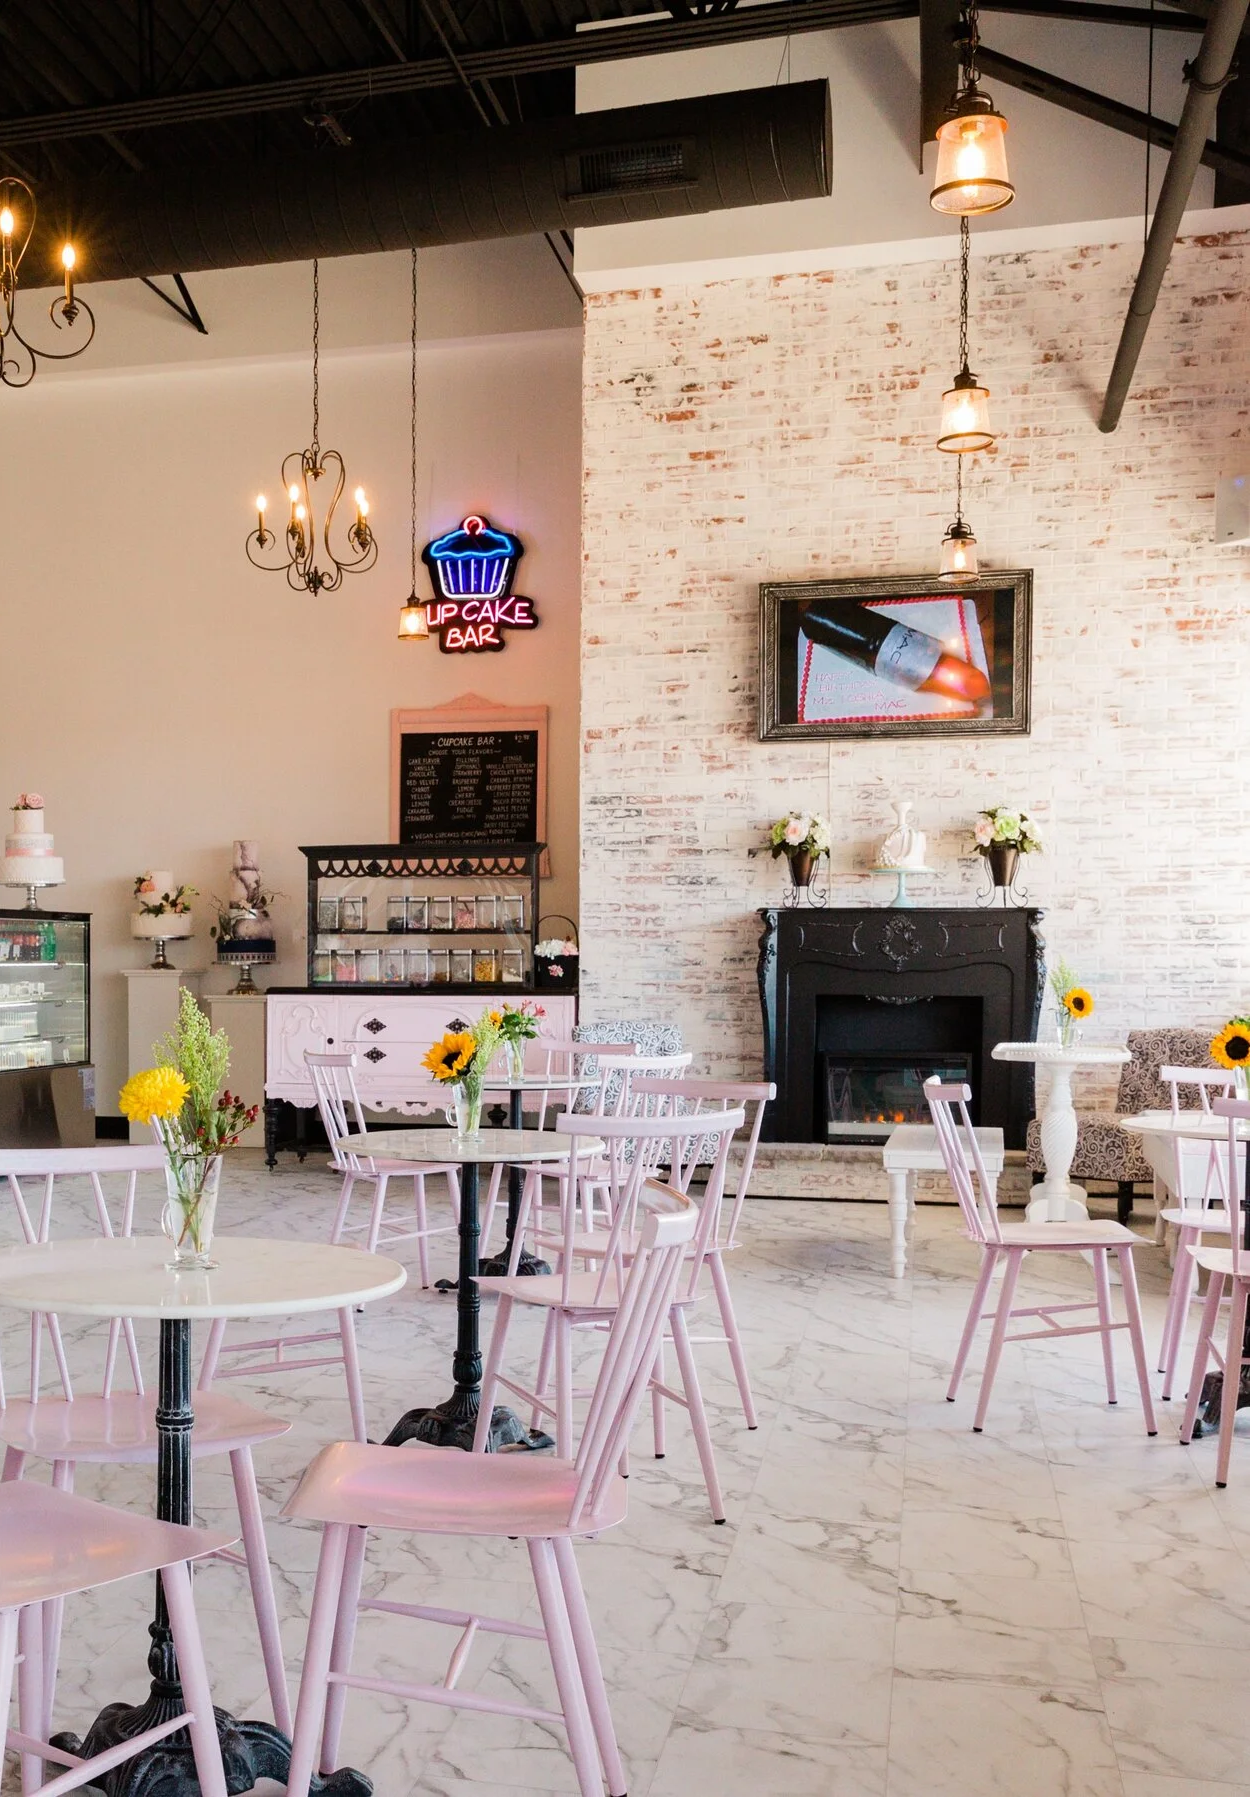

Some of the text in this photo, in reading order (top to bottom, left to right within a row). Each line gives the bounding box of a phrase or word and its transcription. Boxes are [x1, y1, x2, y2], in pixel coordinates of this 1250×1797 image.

[426, 597, 533, 625] UPCAKE
[445, 623, 500, 648] BAR
[874, 699, 907, 710] MAC
[437, 736, 495, 747] CUPCAKE BAR
[404, 814, 434, 822] STRAWBERRY
